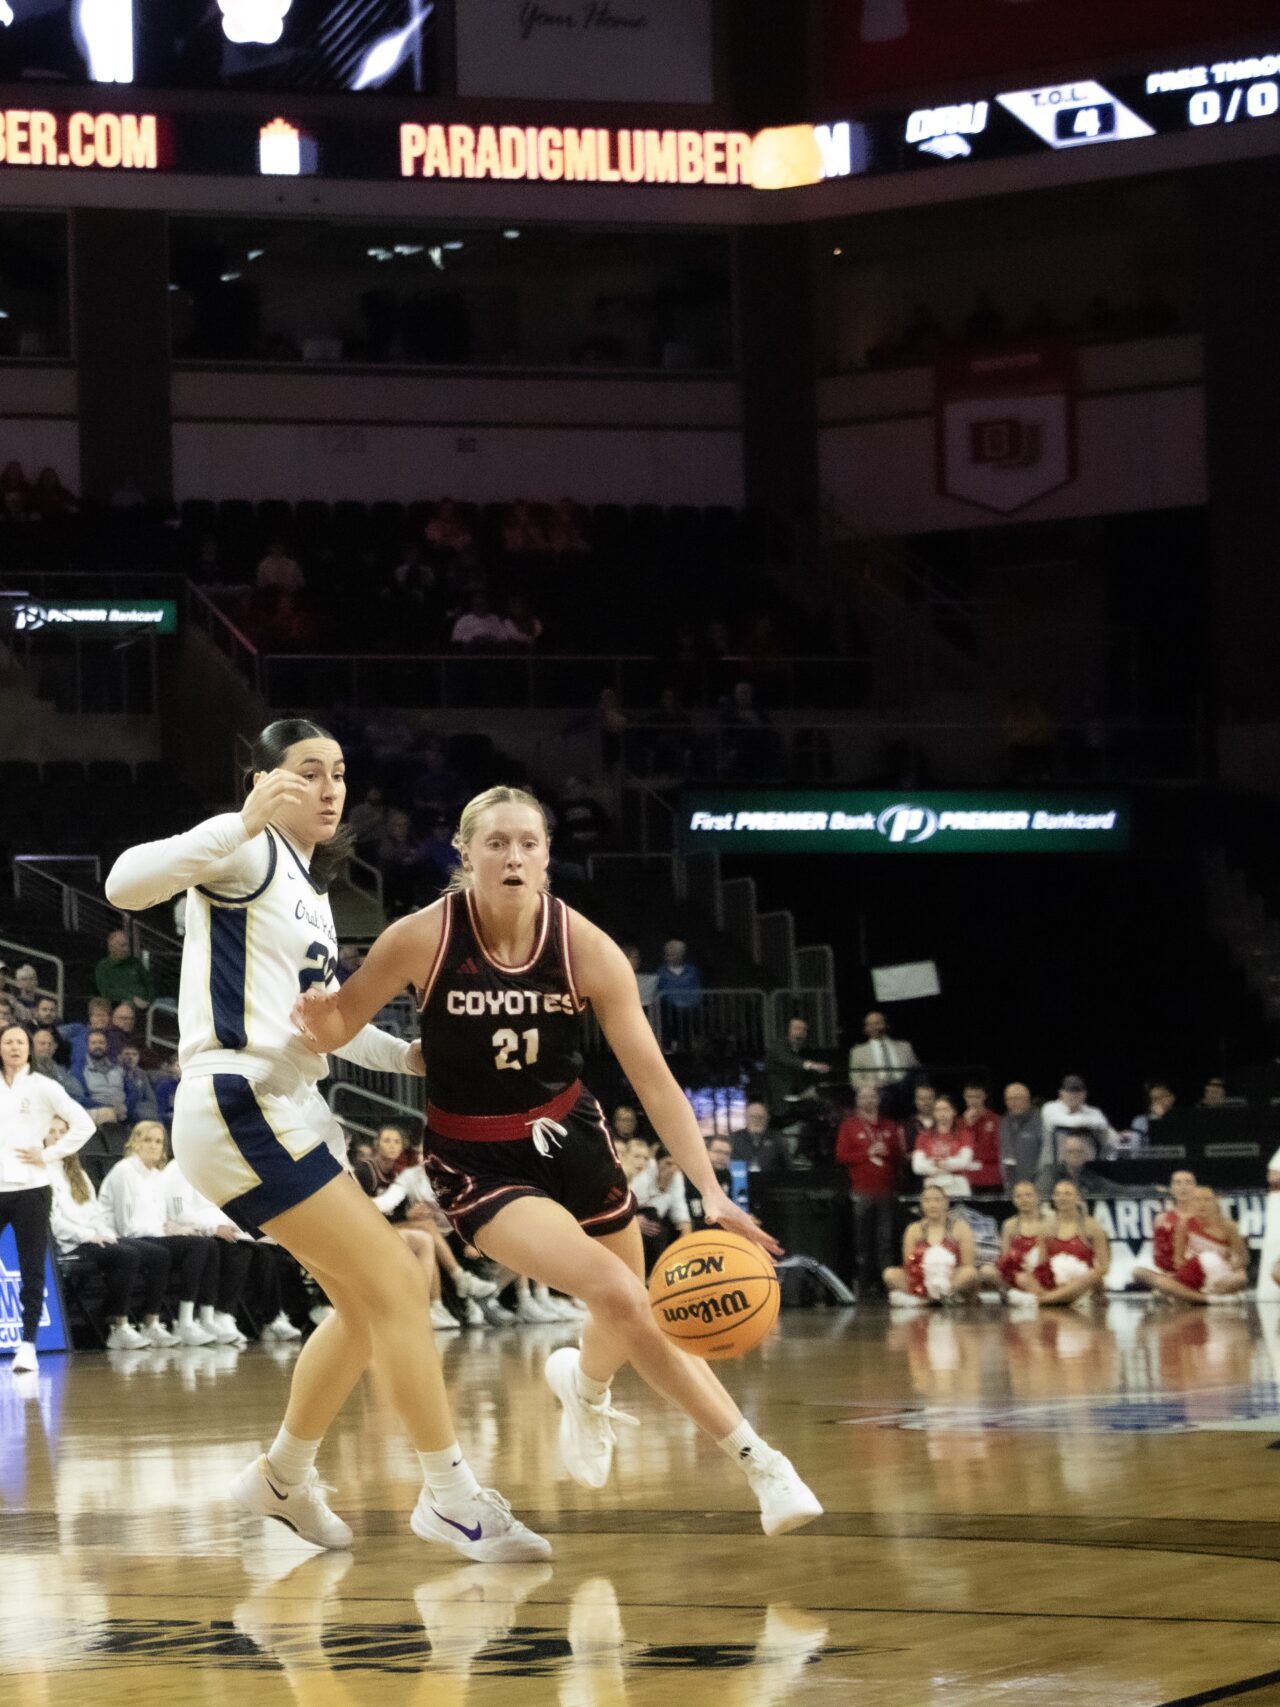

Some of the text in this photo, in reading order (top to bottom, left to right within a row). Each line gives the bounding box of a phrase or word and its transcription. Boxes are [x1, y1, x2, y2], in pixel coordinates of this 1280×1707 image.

[1210, 54, 1280, 84] THRO
[1073, 108, 1100, 137] 4
[691, 811, 734, 830] First
[734, 811, 828, 831] PREMIER
[829, 812, 876, 831] Bank
[938, 810, 1030, 831] PREMIER
[1030, 811, 1117, 831] Bankcard
[446, 990, 575, 1016] COYOTES
[491, 1028, 540, 1072] 21
[665, 1256, 724, 1287] NCAA
[663, 1290, 751, 1323] Wilson
